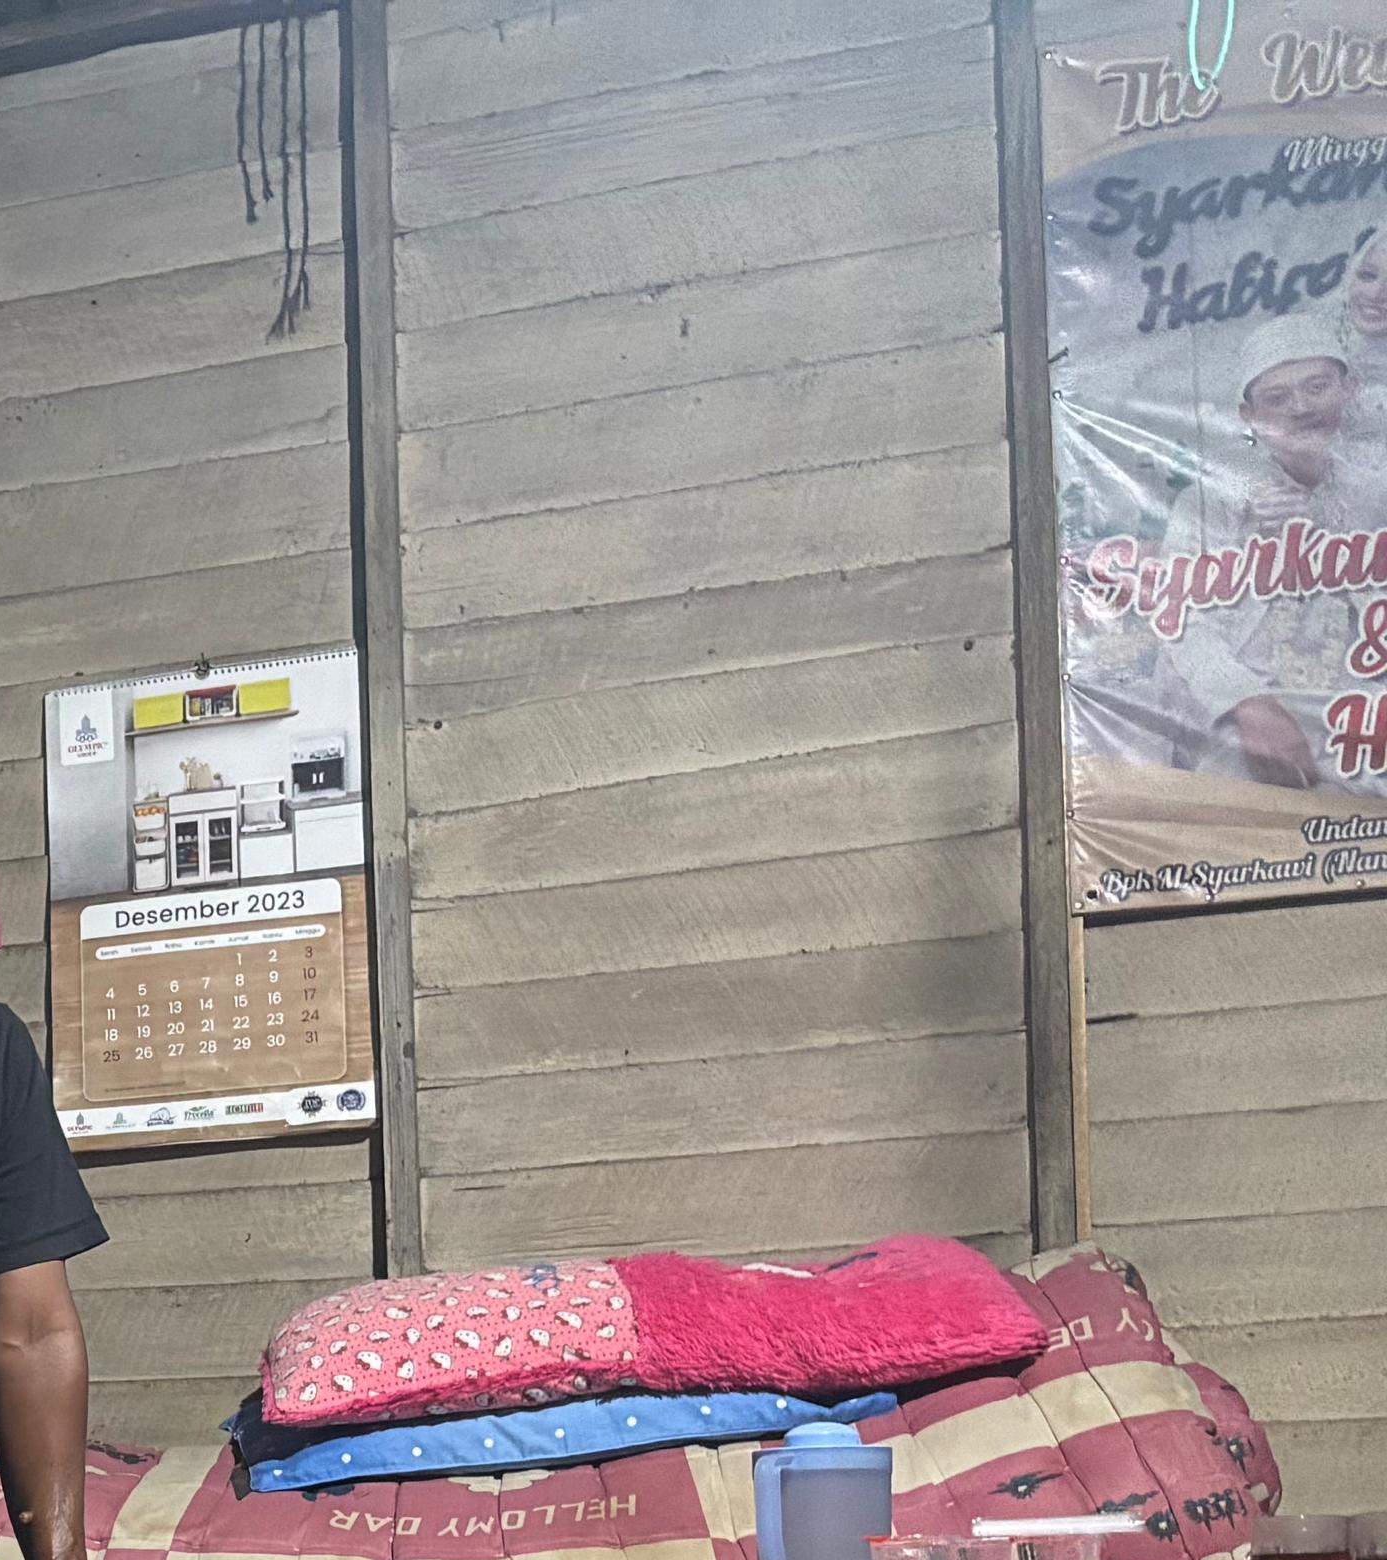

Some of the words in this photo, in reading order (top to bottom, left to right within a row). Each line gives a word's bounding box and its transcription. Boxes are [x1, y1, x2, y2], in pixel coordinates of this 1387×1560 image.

[1101, 868, 1154, 900] Bpk
[1190, 852, 1315, 894] Syarkawi
[115, 899, 240, 929] Desember
[247, 889, 306, 914] 2023
[268, 948, 278, 963] 2
[105, 987, 115, 999] 4
[138, 983, 147, 996] 5
[169, 979, 180, 993] 6
[201, 976, 211, 990] 7
[235, 973, 245, 987] 8
[269, 970, 279, 983] 9
[303, 967, 317, 980] 10
[107, 1008, 116, 1021] 11
[136, 1004, 151, 1018] 12
[168, 1000, 182, 1014] 13
[199, 998, 214, 1011] 14
[233, 994, 248, 1008] 15
[267, 991, 282, 1005] 16
[303, 987, 317, 1001] 17
[105, 1028, 119, 1042] 18
[137, 1025, 151, 1039] 19
[167, 1021, 185, 1036] 20
[201, 1018, 215, 1033] 21
[232, 1015, 250, 1030] 22
[266, 1012, 284, 1026] 23
[301, 1009, 320, 1023] 24
[103, 1049, 121, 1063] 25
[135, 1046, 153, 1060] 26
[167, 1043, 185, 1057] 27
[199, 1040, 217, 1054] 28
[233, 1036, 252, 1051] 29
[266, 1033, 286, 1048] 30
[305, 1030, 319, 1044] 31
